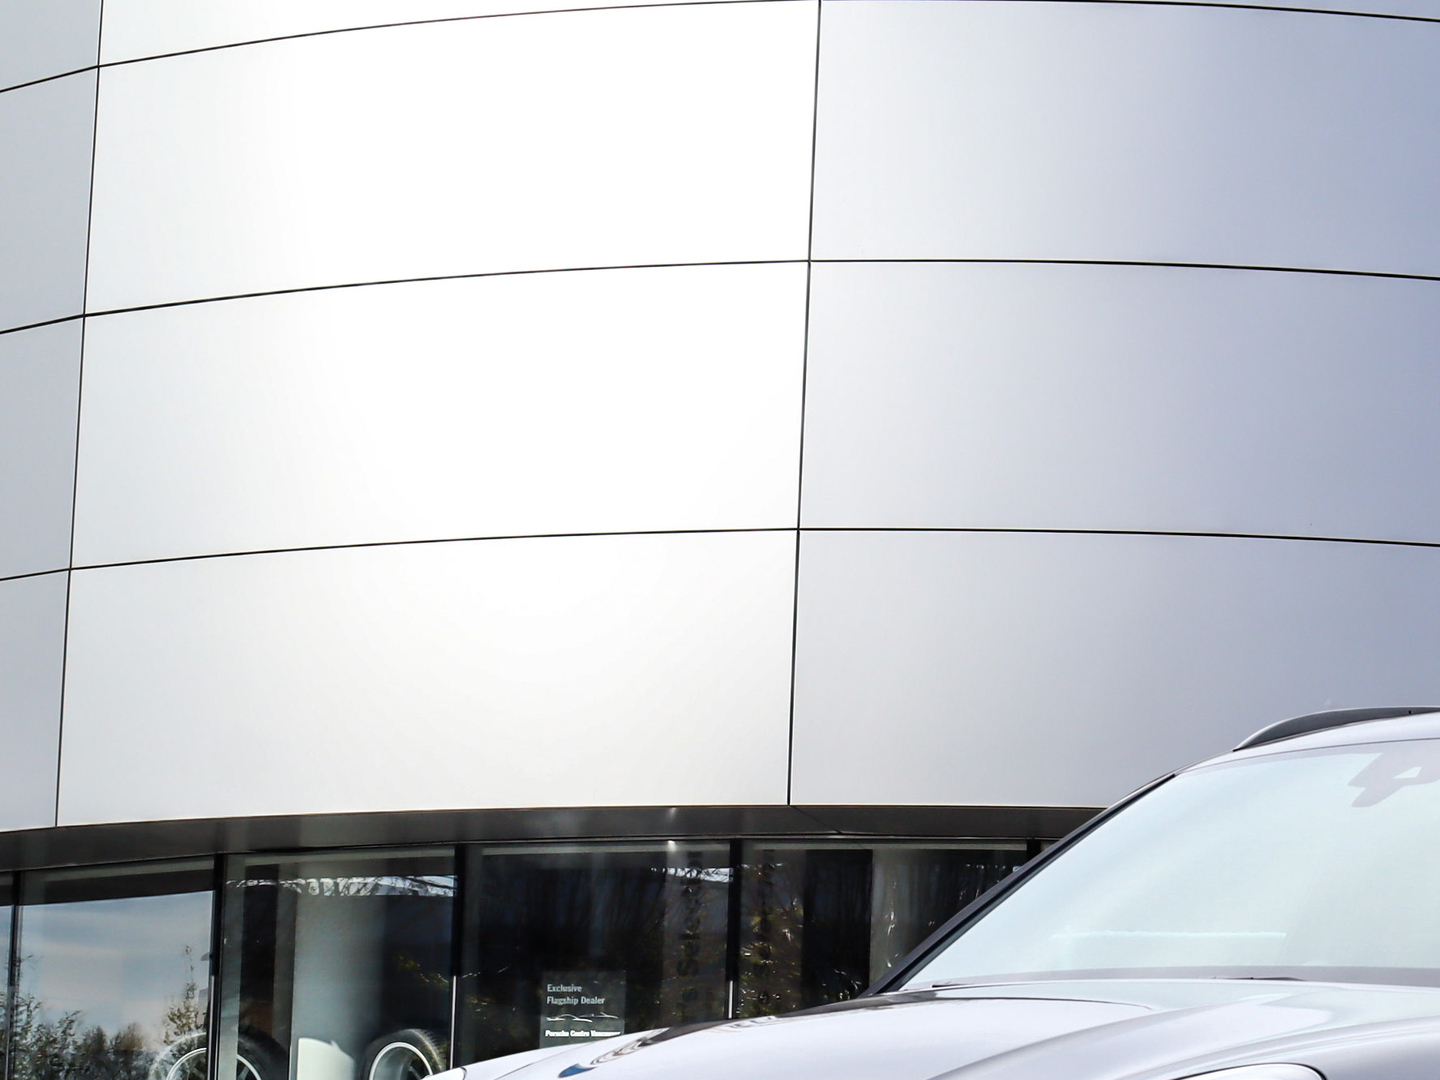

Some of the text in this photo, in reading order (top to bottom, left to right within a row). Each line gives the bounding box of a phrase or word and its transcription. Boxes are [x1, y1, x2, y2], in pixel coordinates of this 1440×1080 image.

[546, 984, 582, 992] Exclusive
[546, 996, 605, 1006] Flagship Dealer
